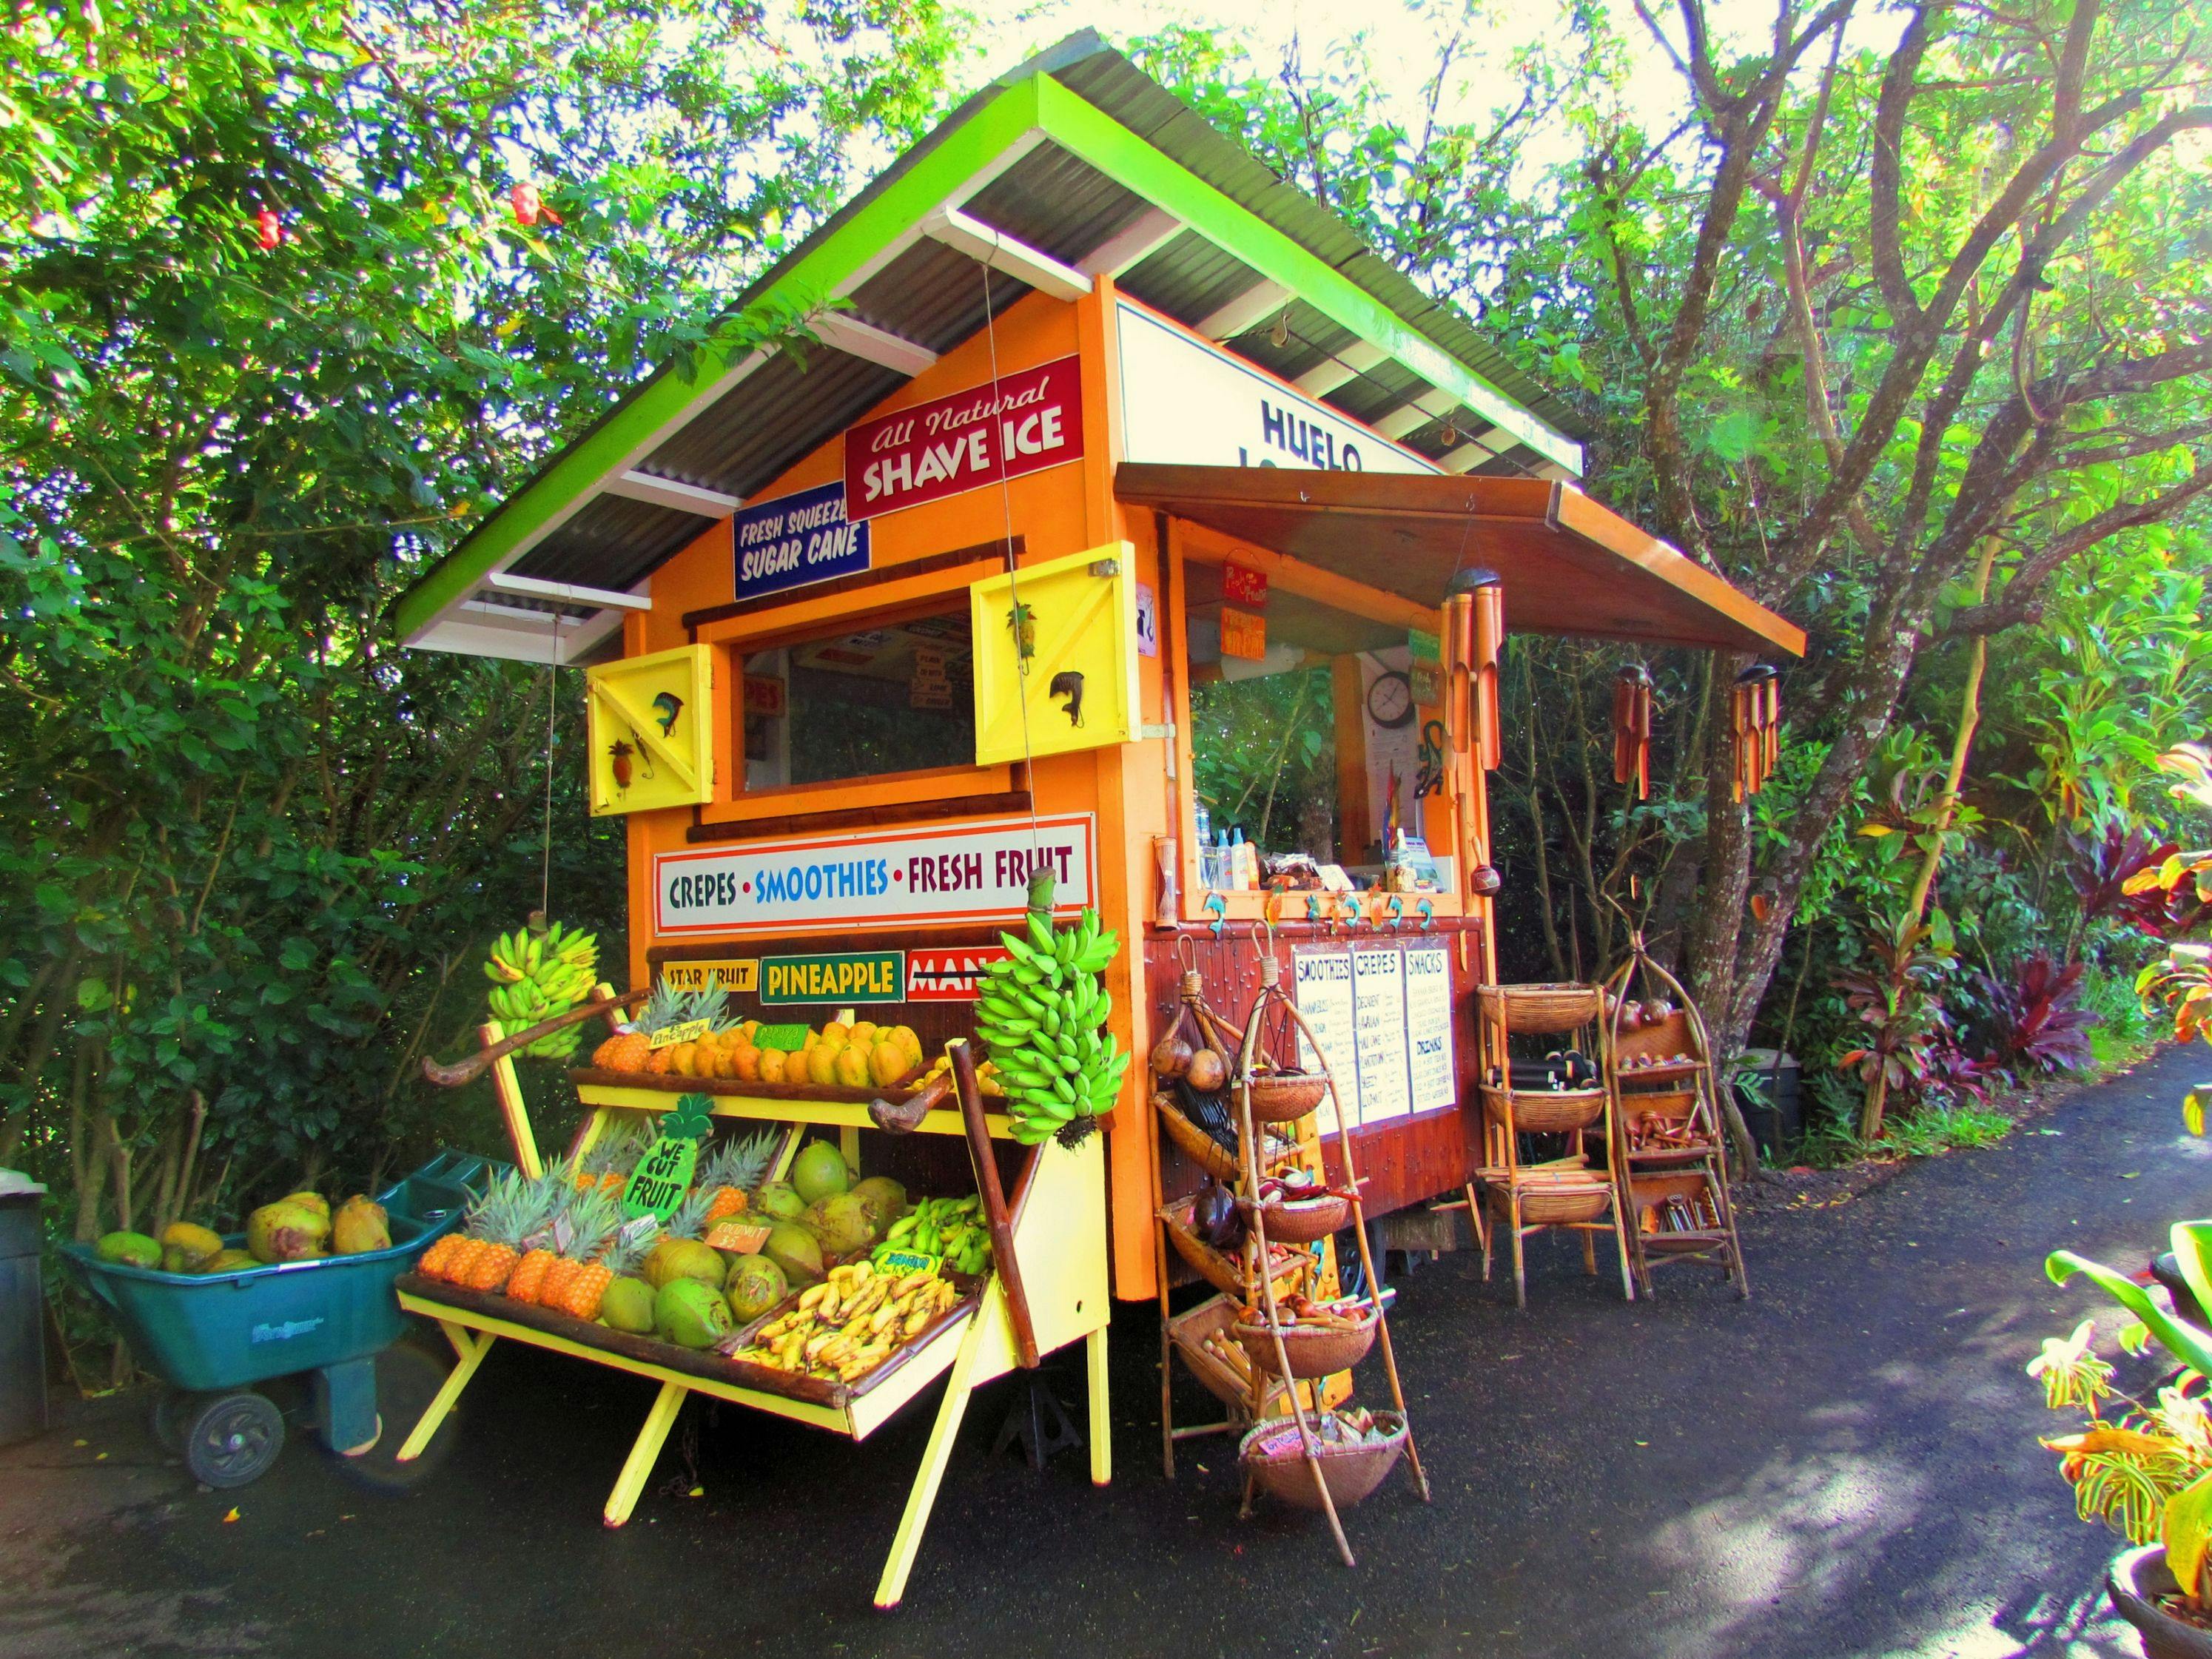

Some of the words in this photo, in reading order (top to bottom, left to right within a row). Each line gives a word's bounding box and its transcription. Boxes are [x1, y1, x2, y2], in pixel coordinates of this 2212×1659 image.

[872, 420, 914, 453] All
[926, 376, 1049, 434] Natural
[1261, 400, 1362, 471] HUELO
[863, 429, 989, 502] SHAVE
[1003, 406, 1065, 461] ICE
[740, 517, 783, 548] FRESH
[742, 542, 801, 582] SUGAR
[807, 523, 861, 564] CANE
[670, 872, 736, 909] CREPES
[756, 858, 888, 903] SMOOTHIES
[909, 853, 983, 893] FRESH
[995, 846, 1072, 888] FRUIT
[670, 969, 702, 985] STAR
[907, 956, 1007, 992] MAN
[1298, 959, 1350, 982] SMOOTHIES
[1356, 953, 1396, 976] CREPES
[1408, 952, 1442, 975] SNACKS
[767, 960, 895, 997] PINEAPPLE
[1416, 1036, 1442, 1055] DRINKS
[660, 1141, 685, 1161] WE
[646, 1157, 679, 1178] CUT
[628, 1175, 682, 1210] FRUIT
[716, 1222, 766, 1238] COCONUT
[719, 1235, 739, 1248] $5
